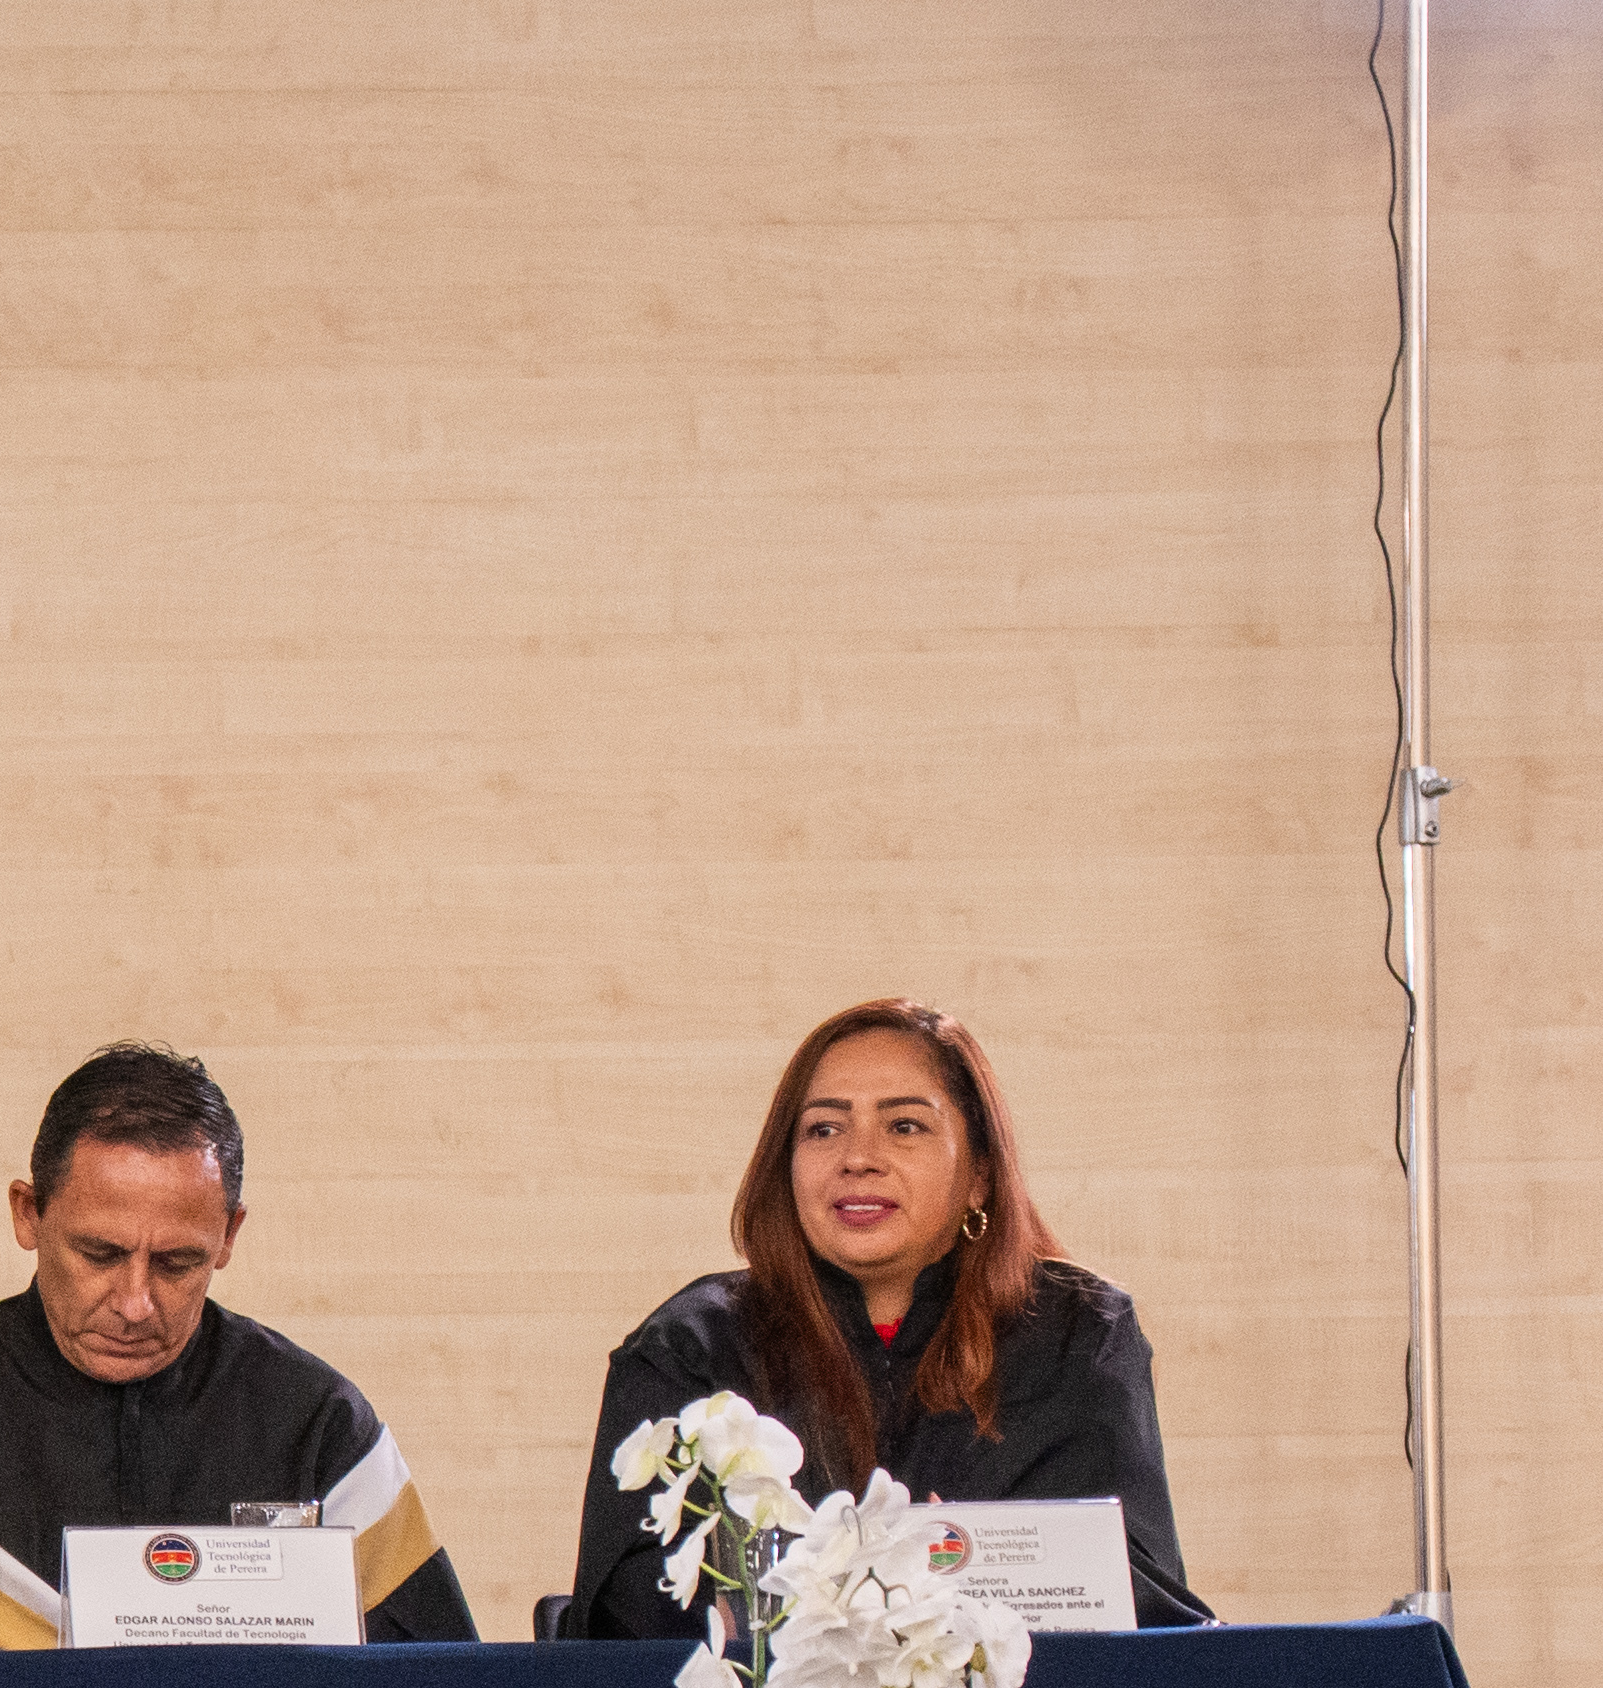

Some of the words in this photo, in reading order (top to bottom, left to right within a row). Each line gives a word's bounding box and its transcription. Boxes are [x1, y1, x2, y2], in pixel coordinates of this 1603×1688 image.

[974, 1526, 1039, 1537] Universidad
[205, 1539, 271, 1549] Universidad
[977, 1539, 1040, 1551] Tecnológica
[207, 1551, 272, 1563] Tecnológica
[983, 1553, 996, 1563] de
[999, 1552, 1037, 1562] Pereira
[214, 1564, 227, 1574] de
[230, 1564, 267, 1574] Pereira
[967, 1576, 1009, 1586] Señora
[990, 1588, 1025, 1598] VILLA
[1028, 1586, 1086, 1597] SANCHEZ
[196, 1603, 230, 1613] Señor
[1002, 1600, 1064, 1611] gresados
[1066, 1600, 1092, 1609] ante
[1094, 1599, 1105, 1609] el
[115, 1615, 159, 1625] EDGAR
[161, 1616, 213, 1626] ALONSO
[215, 1616, 272, 1626] SALAZAR
[275, 1616, 315, 1627] MARIN
[125, 1628, 169, 1638] Decano
[172, 1628, 222, 1638] Facultad
[225, 1629, 240, 1638] de
